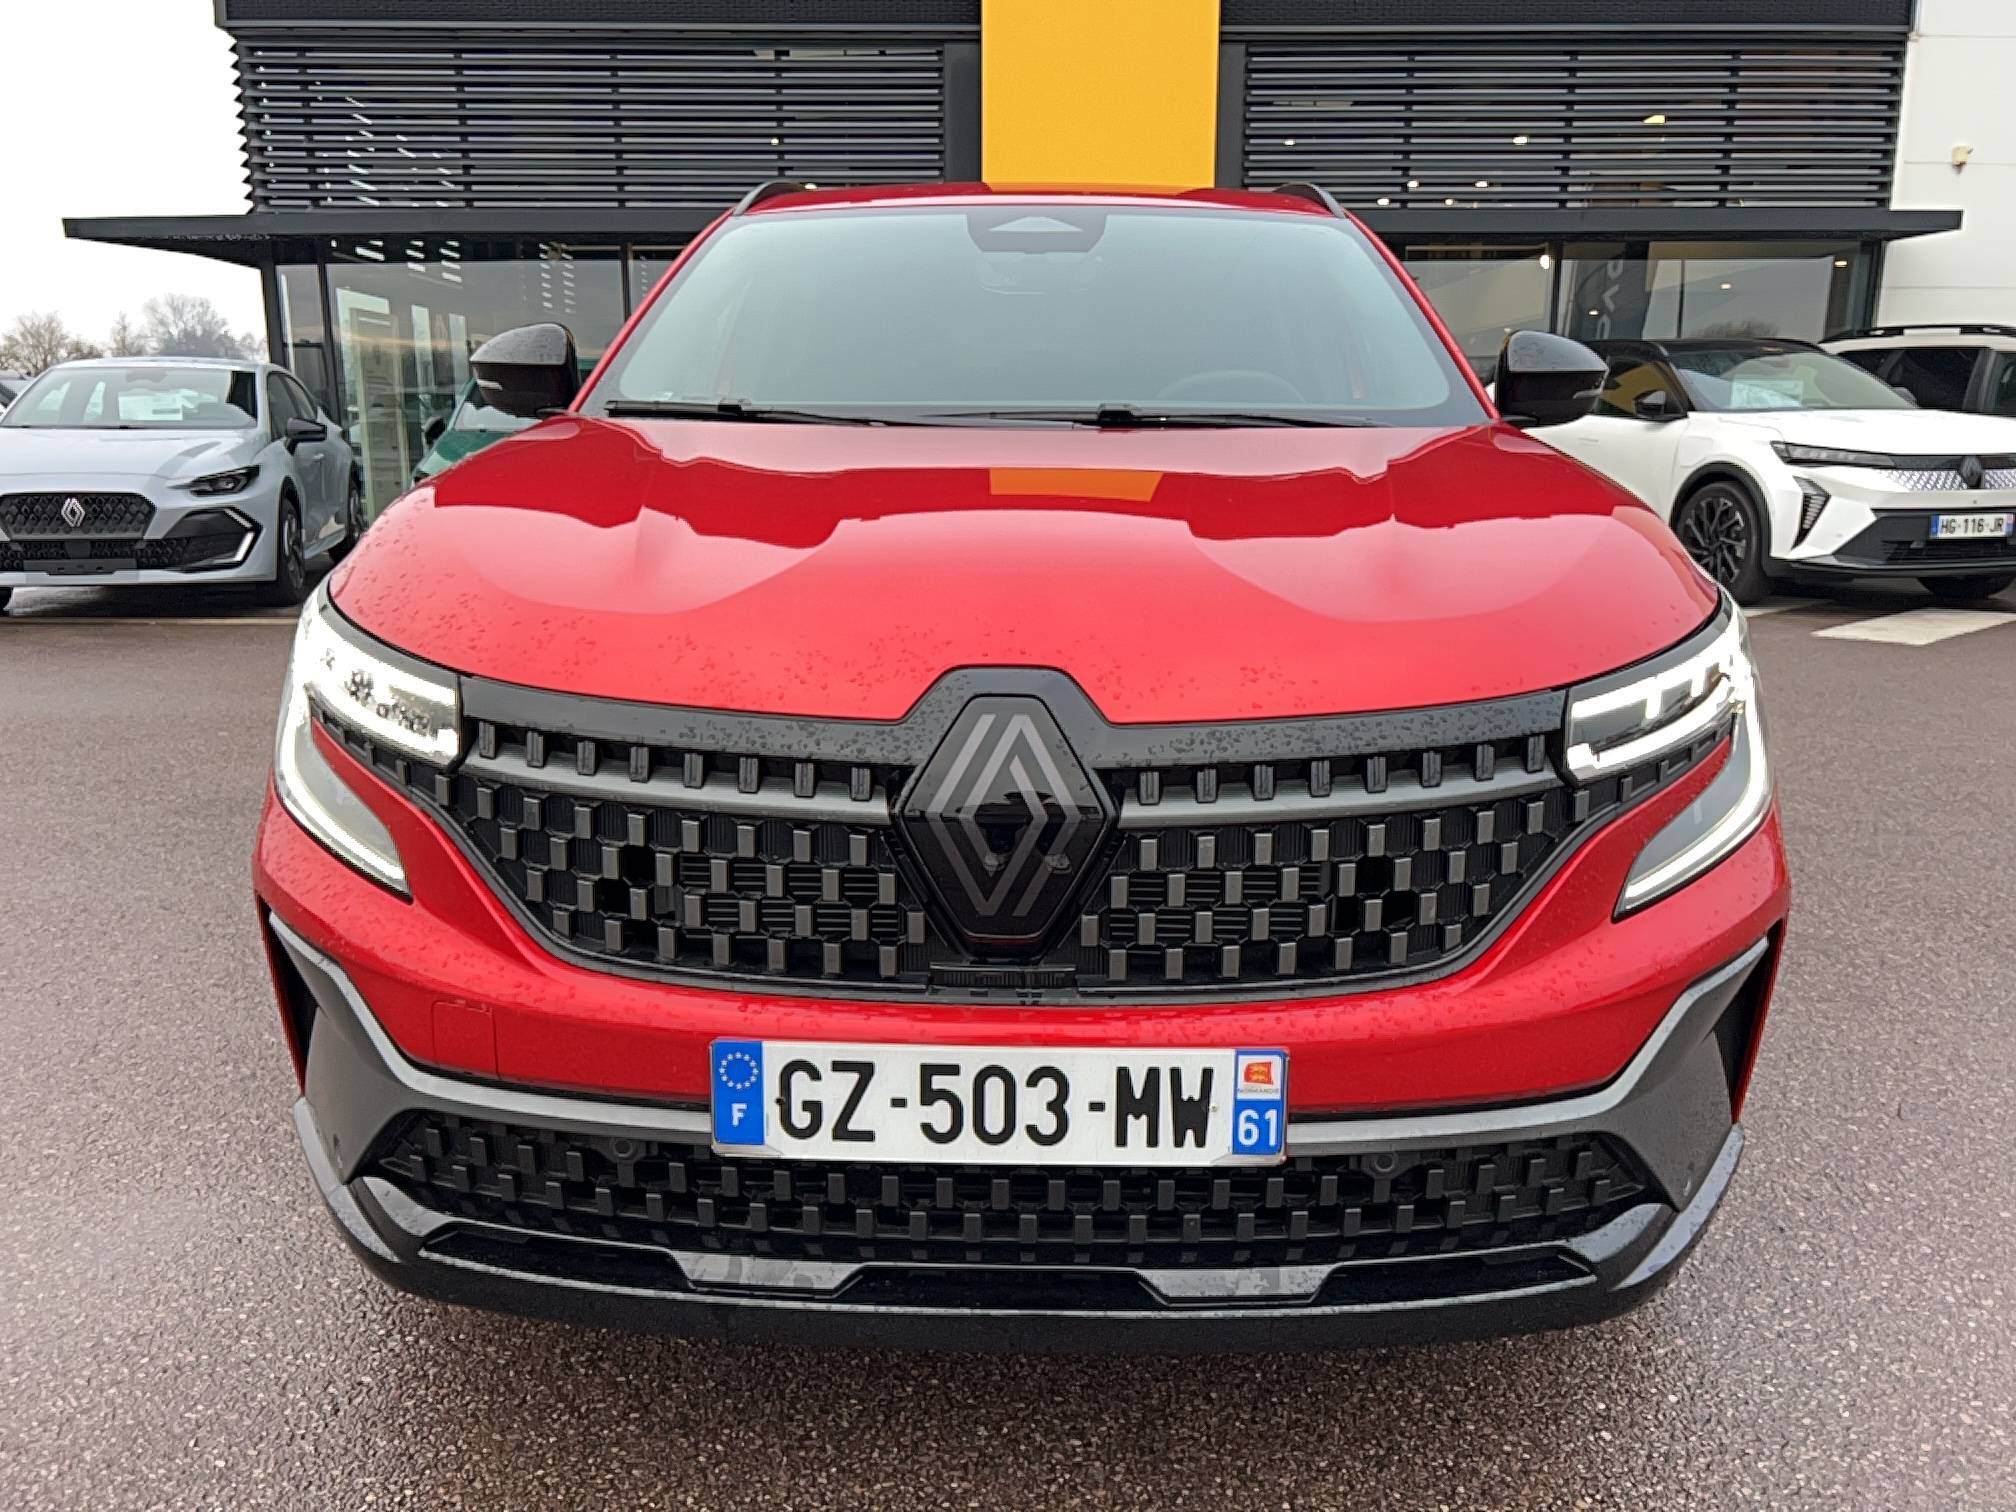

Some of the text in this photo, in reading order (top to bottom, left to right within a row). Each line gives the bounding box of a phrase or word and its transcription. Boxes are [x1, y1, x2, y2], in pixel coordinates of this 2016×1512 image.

[731, 1102, 748, 1127] F
[777, 1059, 1215, 1149] GZ-503-MW
[1238, 1108, 1278, 1147] 61
